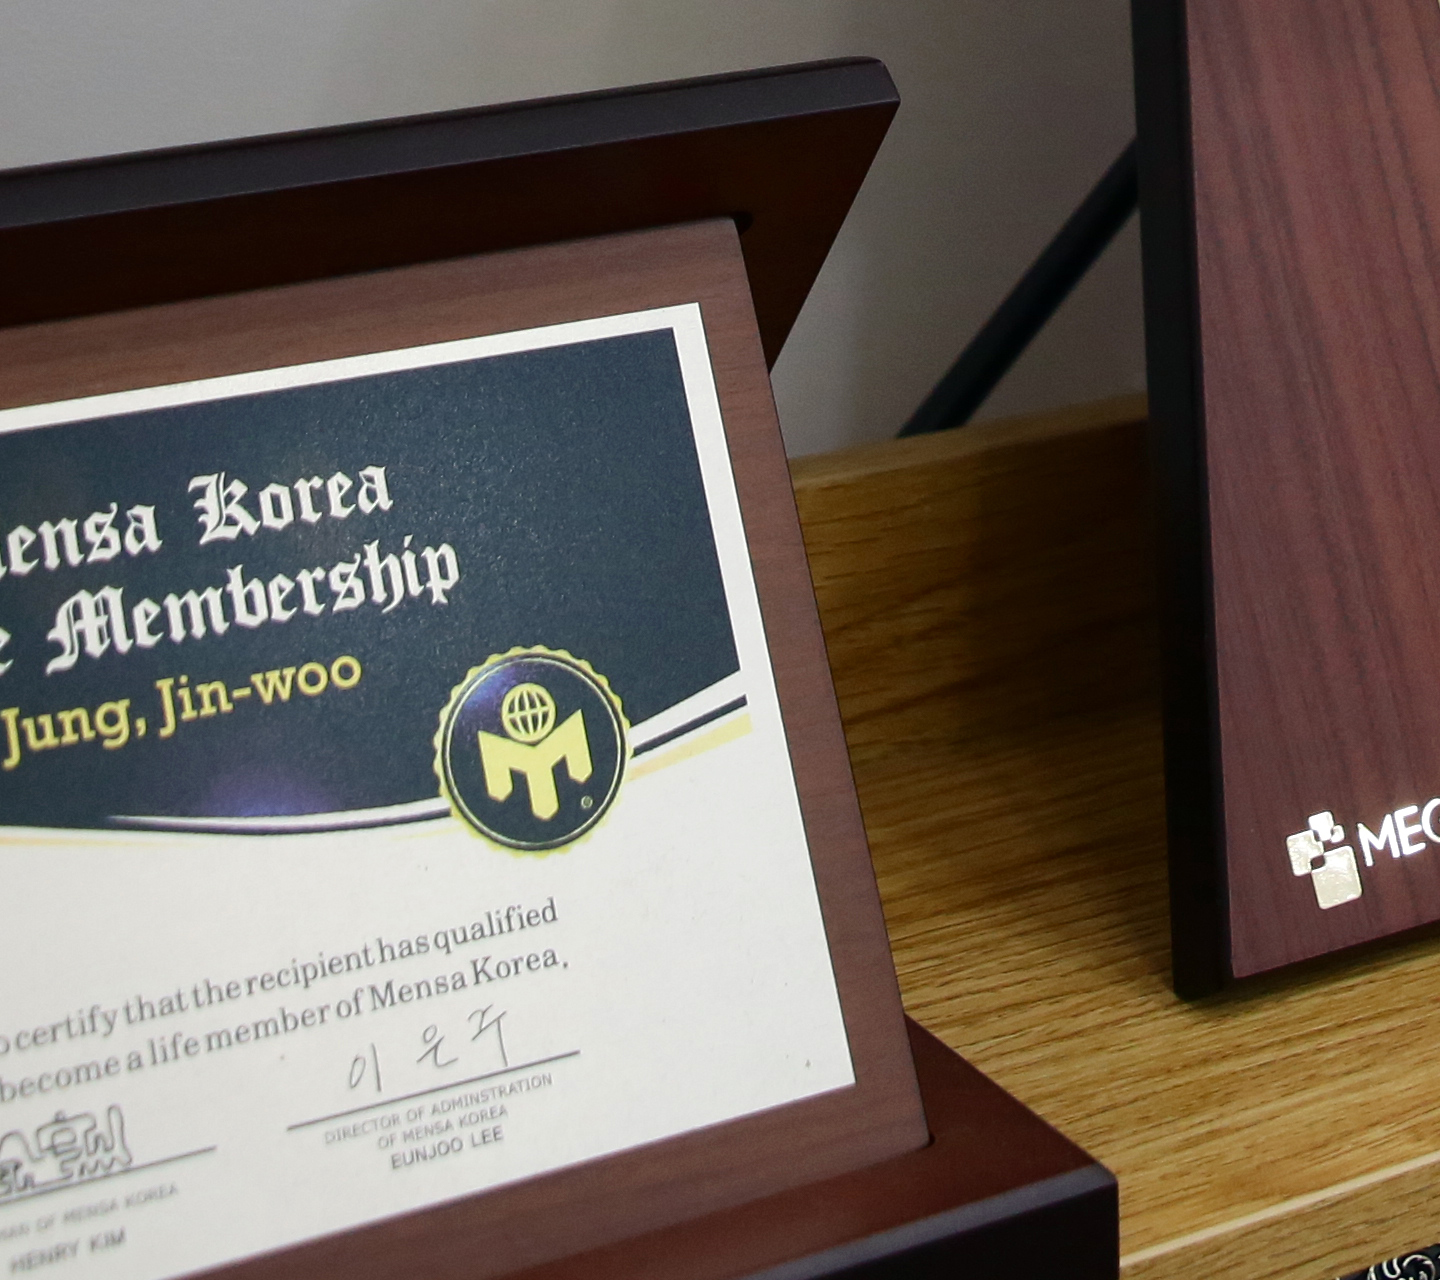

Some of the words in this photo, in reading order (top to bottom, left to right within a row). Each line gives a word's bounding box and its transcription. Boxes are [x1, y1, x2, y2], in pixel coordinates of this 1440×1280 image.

[187, 465, 394, 546] Korea
[46, 535, 460, 674] Membership
[0, 698, 147, 769] Jung,
[156, 655, 362, 737] Jin-woo
[14, 1004, 118, 1052] certify
[123, 989, 189, 1026] that
[192, 979, 241, 1009] the
[245, 944, 375, 996] recipient
[376, 935, 430, 964] has
[433, 896, 558, 955] qualified
[127, 1051, 144, 1073] a
[148, 1032, 199, 1067] life
[205, 1004, 331, 1053] member
[335, 988, 364, 1019] of
[368, 971, 468, 1012] Mensa
[470, 949, 569, 986] Korea.
[389, 1129, 464, 1171] EUNJOO
[471, 1126, 504, 1149] LEE
